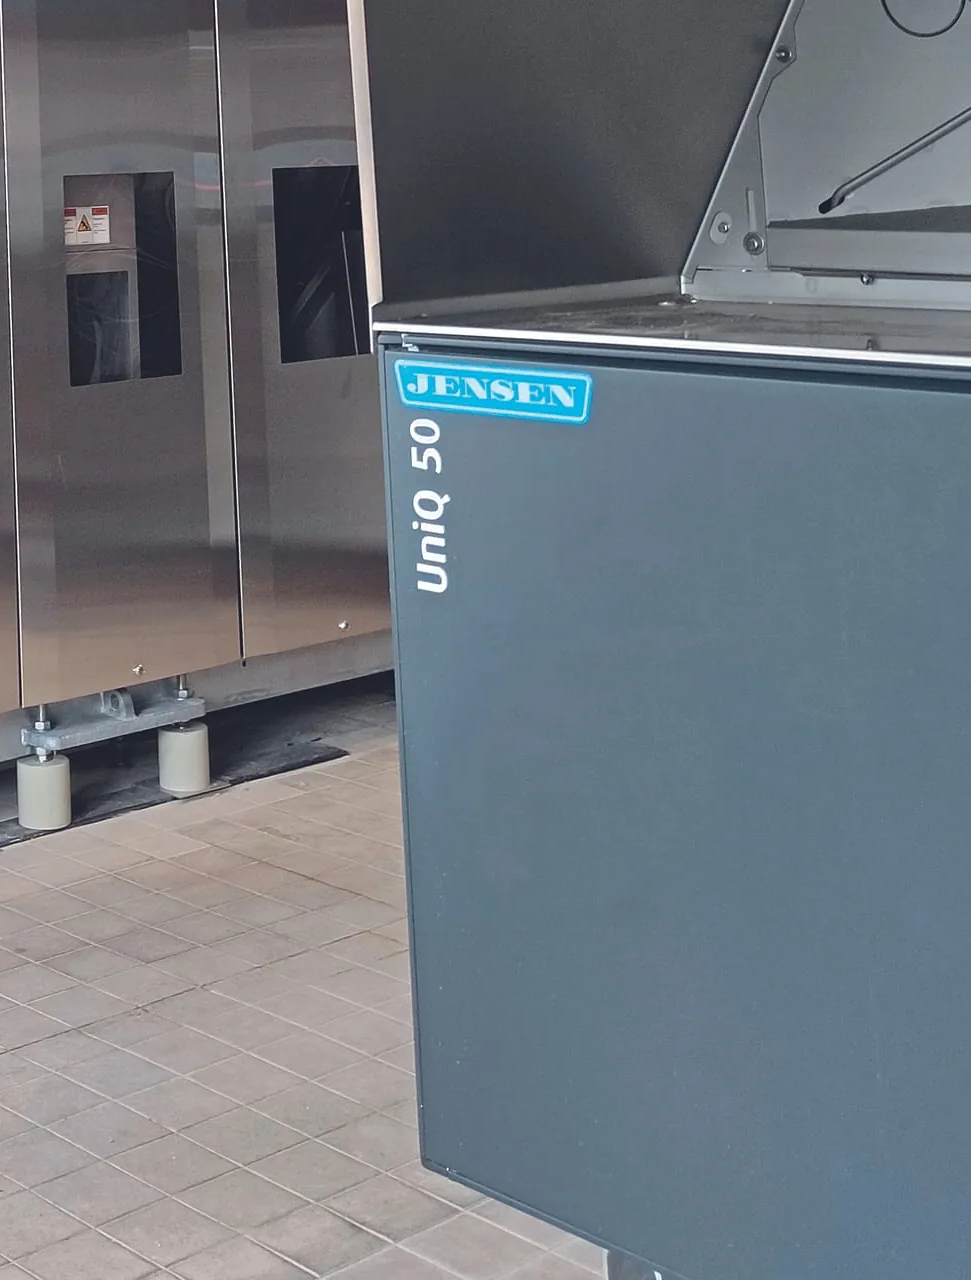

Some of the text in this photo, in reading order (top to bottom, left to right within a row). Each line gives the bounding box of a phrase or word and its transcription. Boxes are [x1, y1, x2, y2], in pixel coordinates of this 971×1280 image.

[407, 372, 576, 408] JENSEN
[409, 418, 451, 594] UniQ 50
